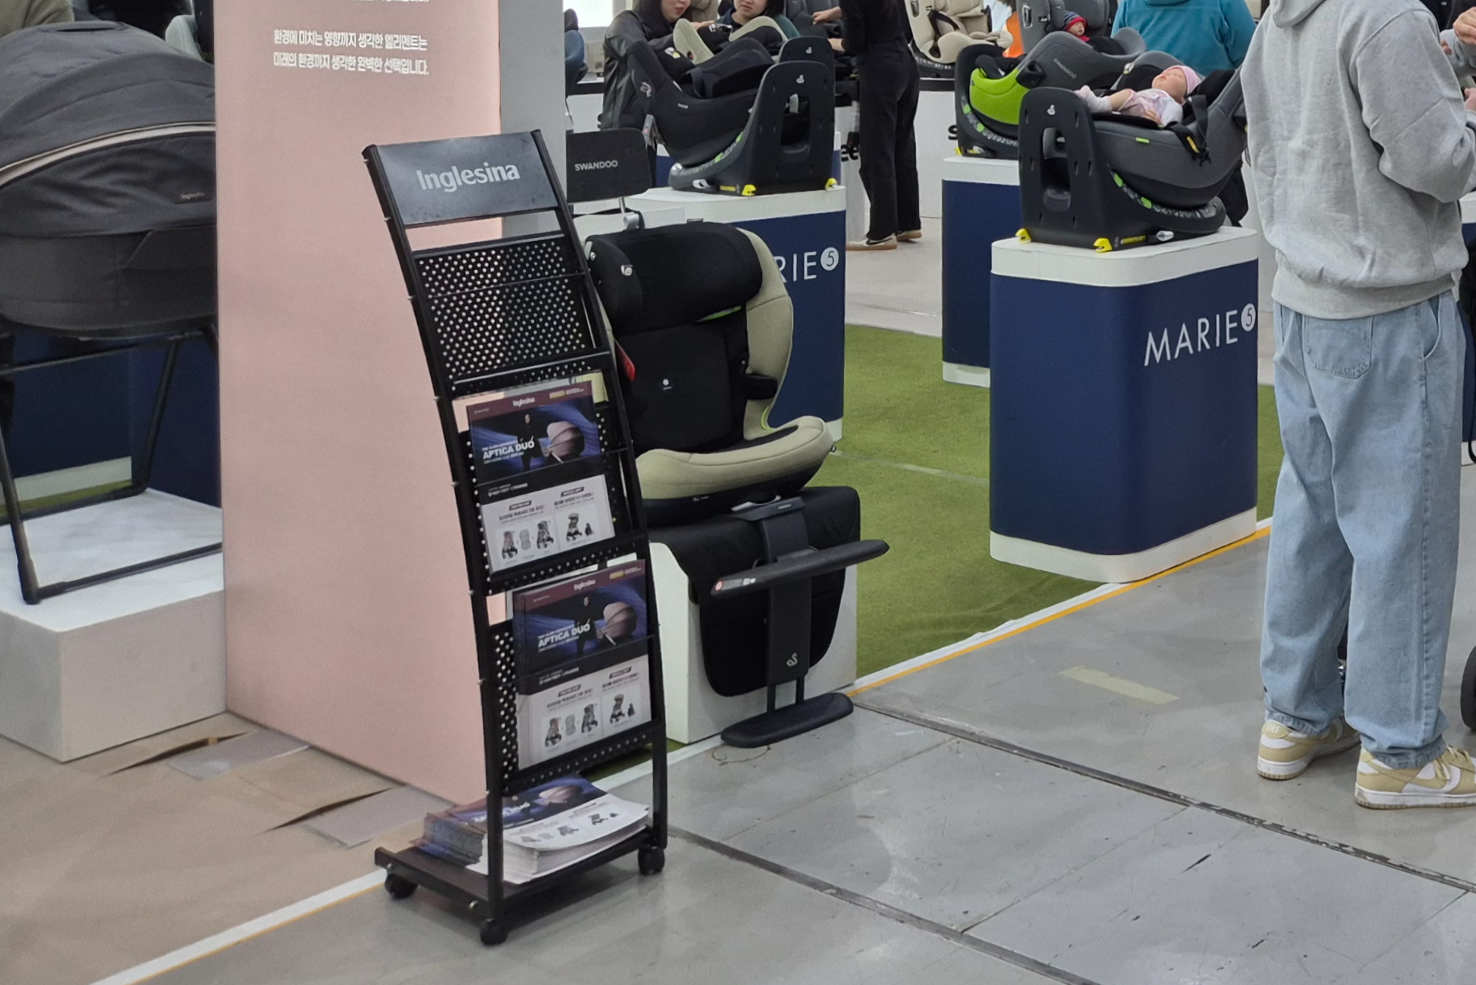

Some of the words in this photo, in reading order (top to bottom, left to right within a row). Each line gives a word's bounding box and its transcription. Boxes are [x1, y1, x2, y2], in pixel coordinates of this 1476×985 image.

[416, 162, 520, 193] Inglesina
[574, 159, 618, 171] SWANDOO
[774, 251, 817, 283] RIE
[1144, 309, 1239, 367] MARIE
[482, 445, 515, 460] APTICA
[515, 440, 535, 451] DUO
[538, 630, 570, 649] APTICA
[571, 622, 591, 637] DUO
